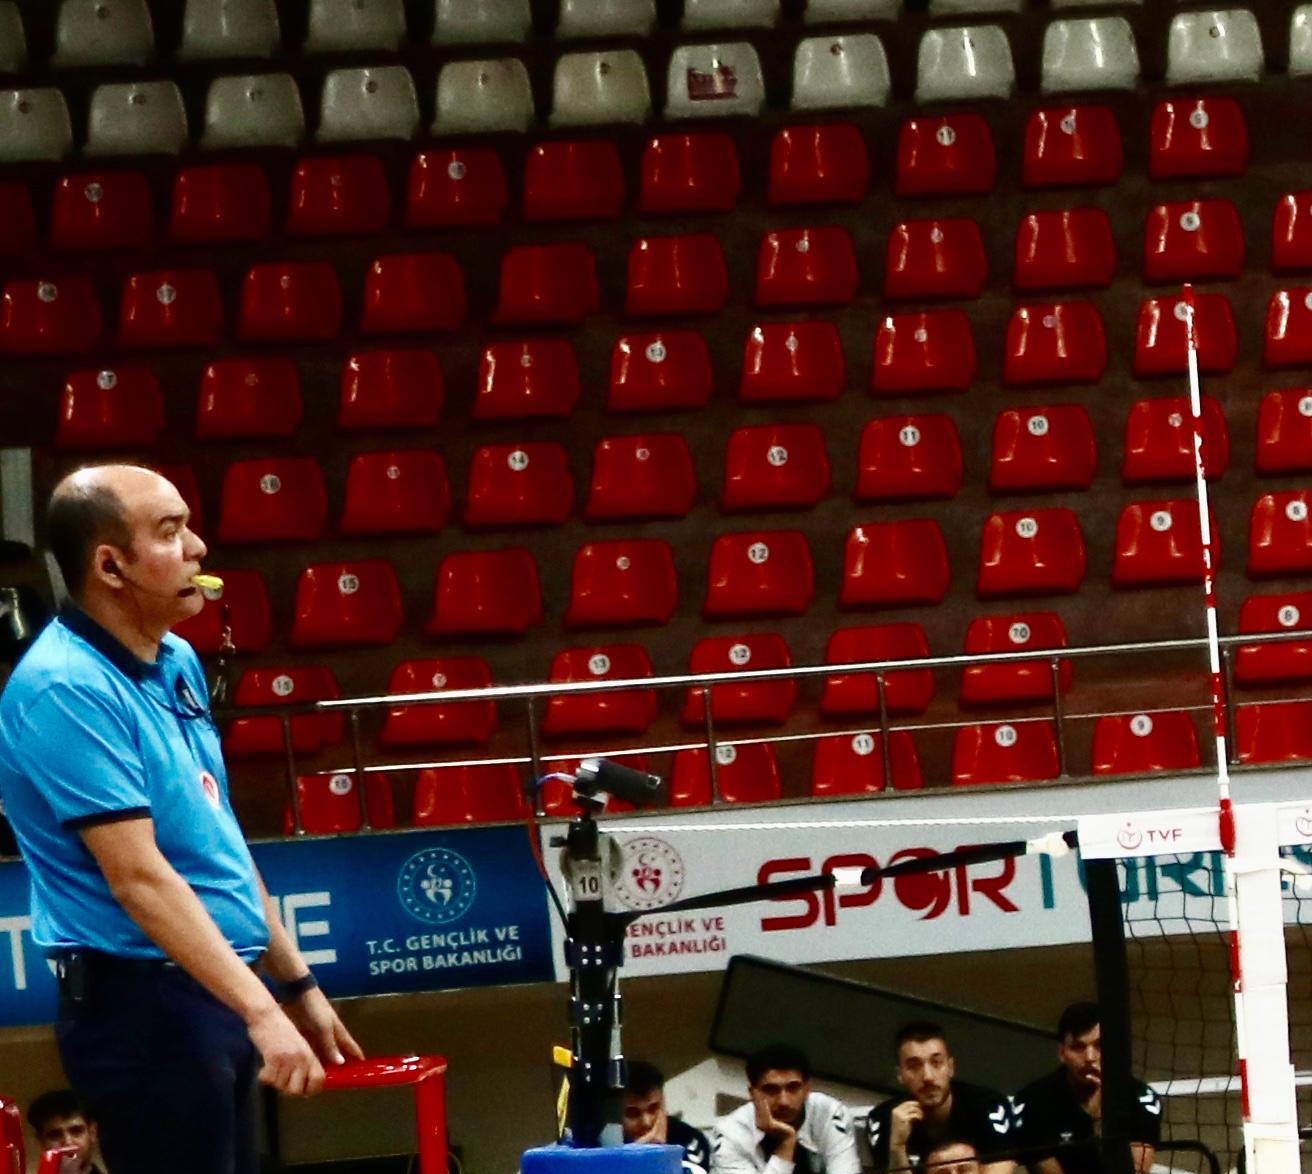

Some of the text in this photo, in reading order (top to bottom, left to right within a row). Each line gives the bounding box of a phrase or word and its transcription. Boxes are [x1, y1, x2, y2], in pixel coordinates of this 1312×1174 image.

[1147, 829, 1183, 842] TVF
[580, 876, 599, 894] 10
[701, 917, 725, 933] VE
[366, 926, 519, 956] T.C. GENÇLİK VE
[631, 937, 728, 959] BAKANLIĞI
[369, 946, 522, 976] SPOR BAKANLIĞI
